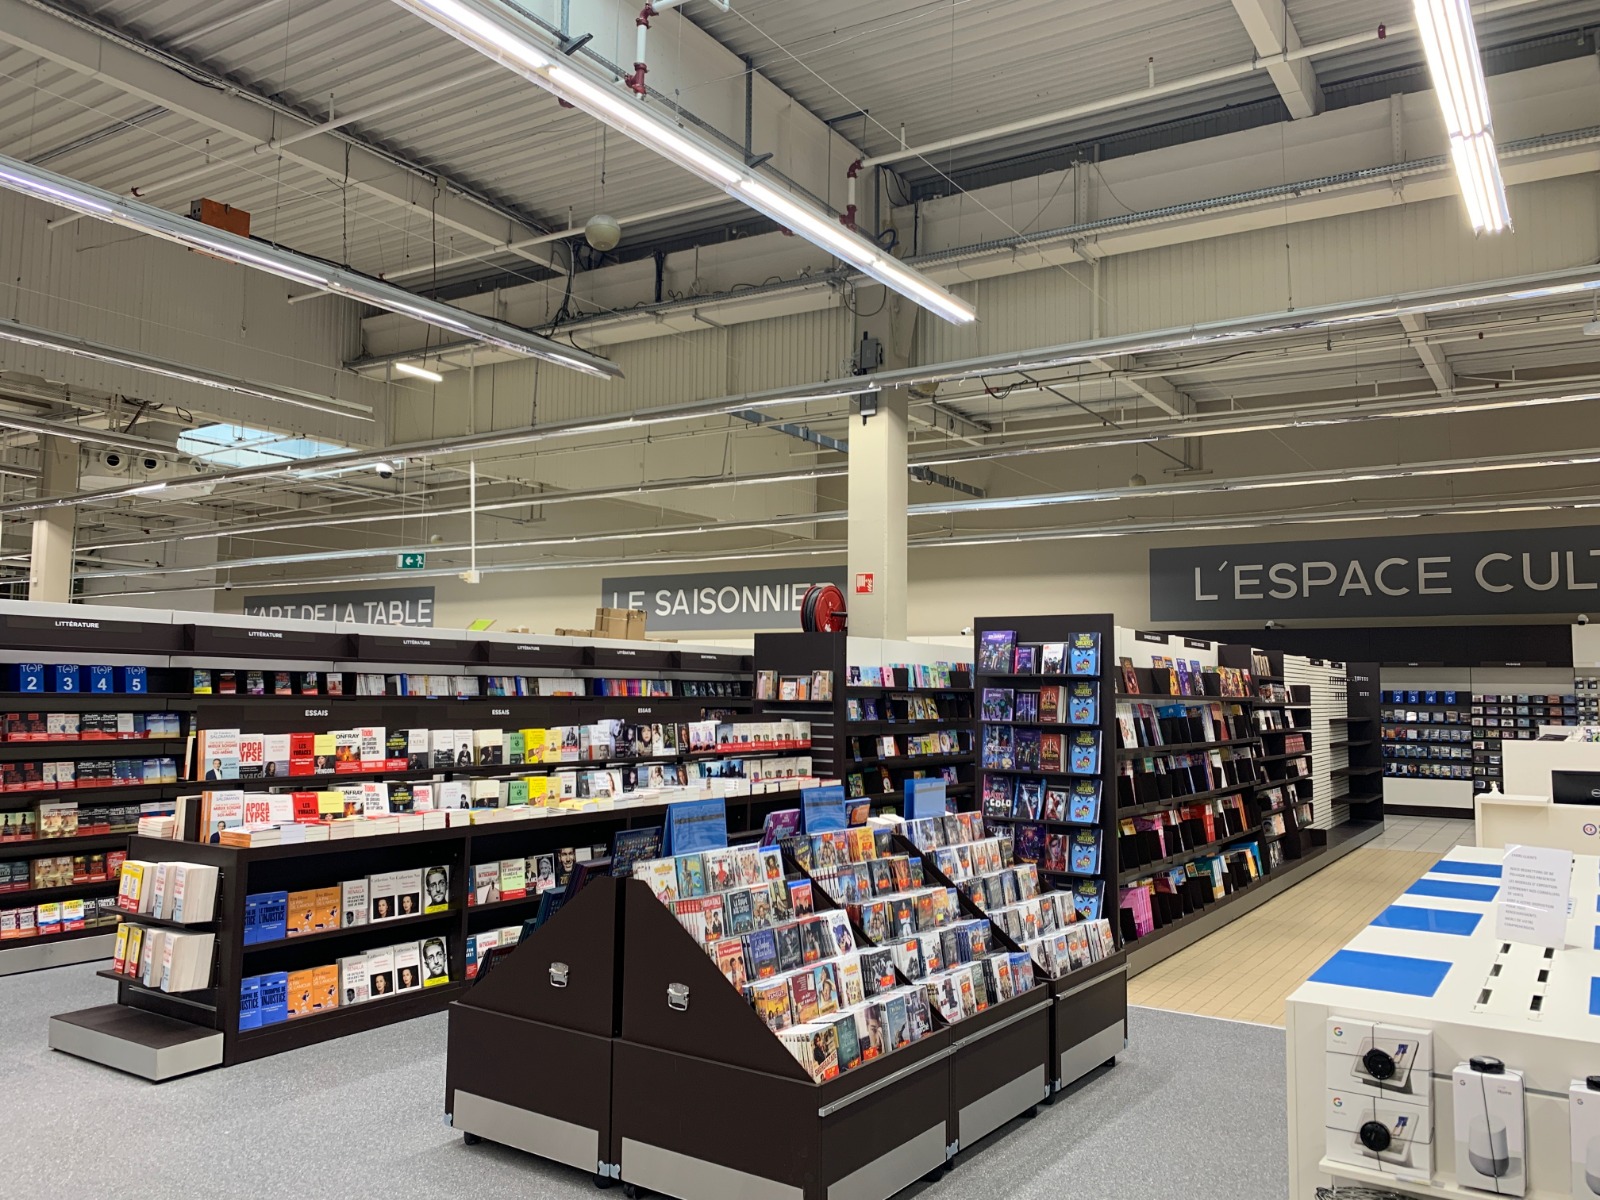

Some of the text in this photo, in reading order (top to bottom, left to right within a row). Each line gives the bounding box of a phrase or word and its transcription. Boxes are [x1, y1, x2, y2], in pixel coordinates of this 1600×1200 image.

[655, 582, 836, 617] SAISONNIE
[364, 599, 433, 625] TABLE
[27, 676, 37, 690] 2
[64, 677, 72, 690] 3
[97, 678, 107, 690] 4
[132, 679, 140, 691] 5
[246, 802, 269, 812] APOCA
[245, 812, 270, 823] LYPSE
[1334, 1027, 1343, 1037] G
[1333, 1097, 1343, 1107] G
